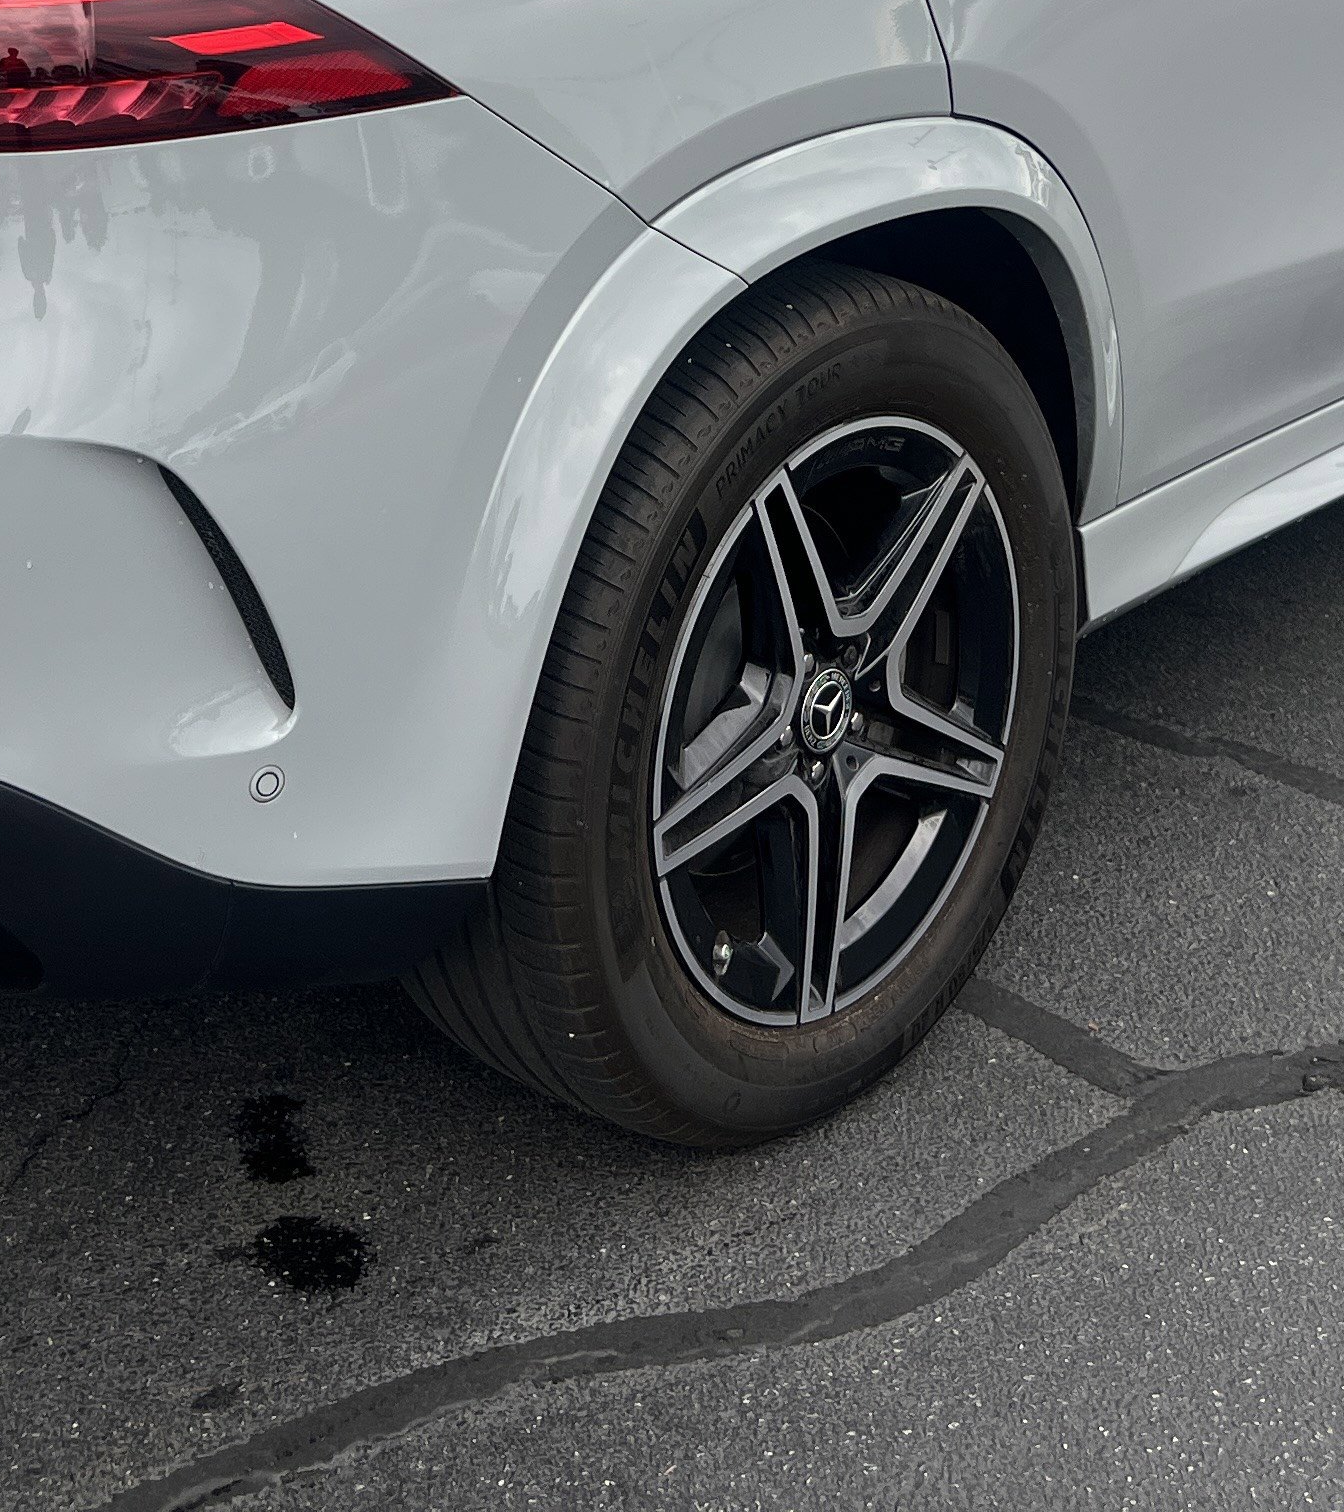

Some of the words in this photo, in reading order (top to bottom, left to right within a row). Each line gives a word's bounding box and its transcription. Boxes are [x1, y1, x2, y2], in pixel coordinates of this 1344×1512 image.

[716, 398, 788, 500] PRIMACY
[794, 362, 841, 408] TOUR
[608, 523, 707, 863] MICHELIN
